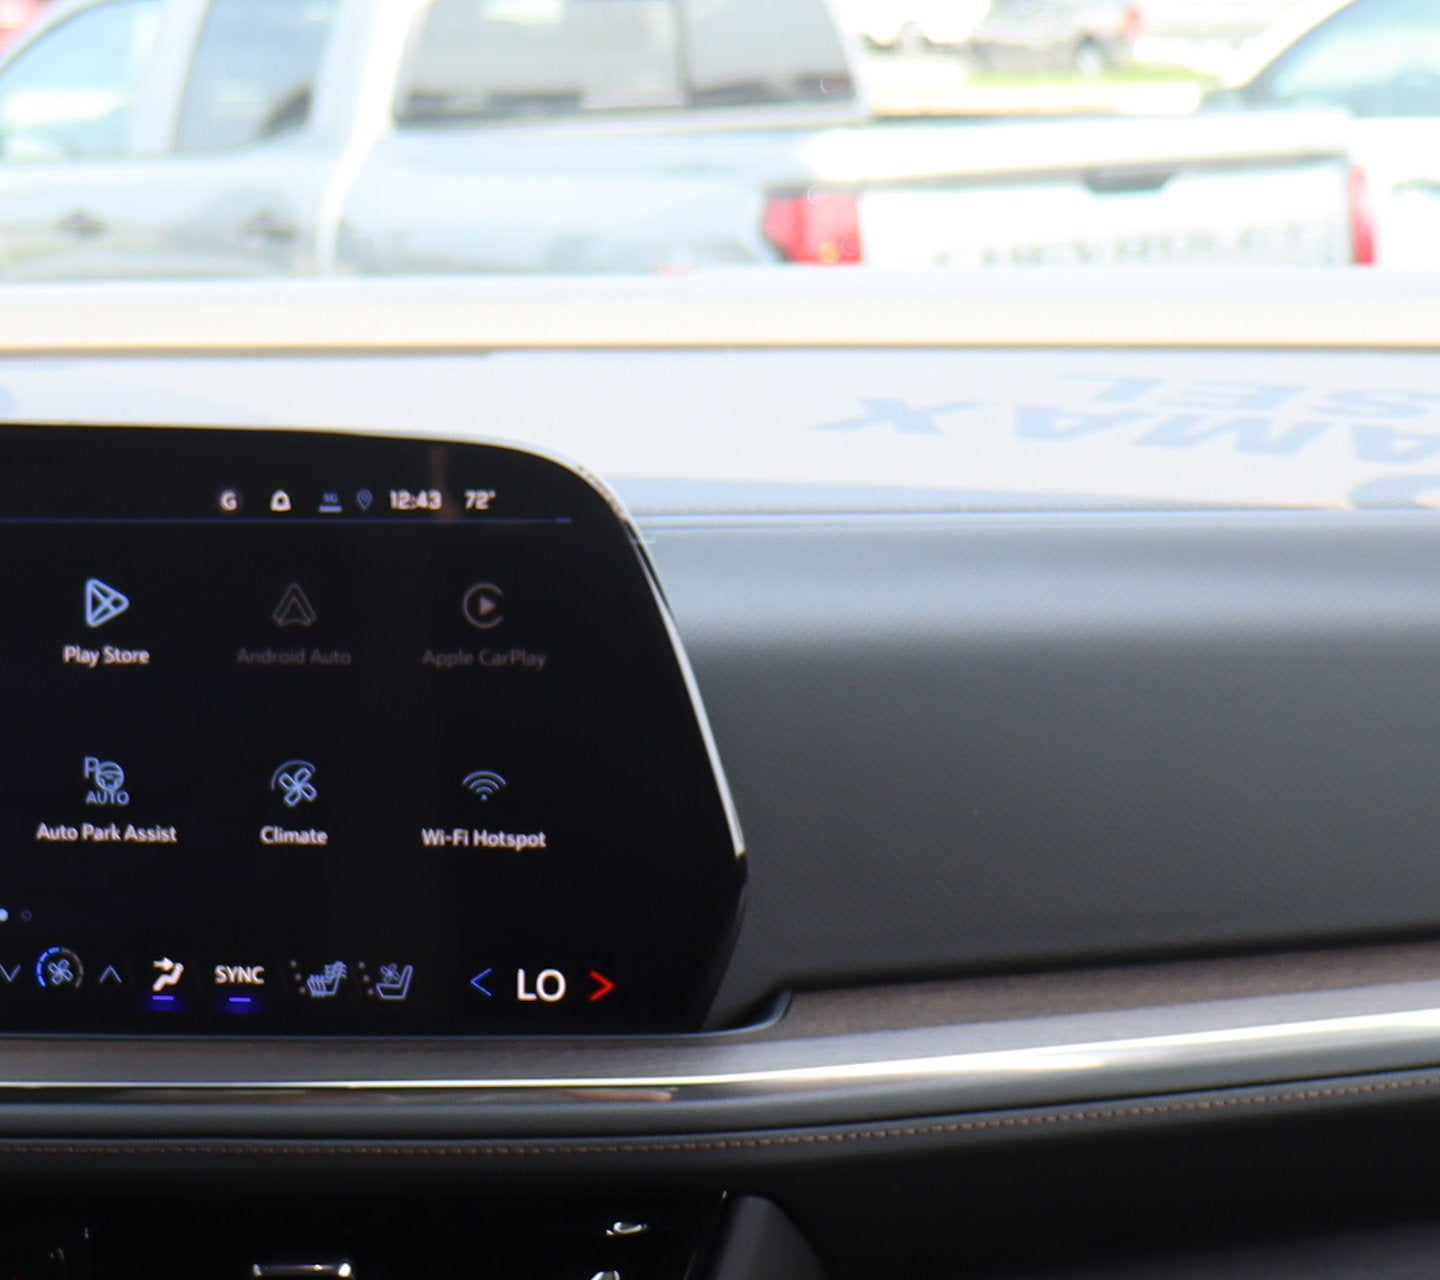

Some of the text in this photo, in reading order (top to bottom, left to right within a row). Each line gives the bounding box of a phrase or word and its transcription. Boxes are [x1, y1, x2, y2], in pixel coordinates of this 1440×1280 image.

[390, 489, 442, 510] 12:43
[63, 644, 150, 668] Play Store
[236, 647, 353, 665] Android Auto
[421, 647, 547, 670] Apple CarPlay
[35, 822, 178, 843] Auto Park Assist
[259, 825, 329, 846] Climate
[421, 827, 547, 852] Wi-Fi Hotspot
[215, 964, 265, 985] SYNC
[517, 968, 567, 1002] LO
